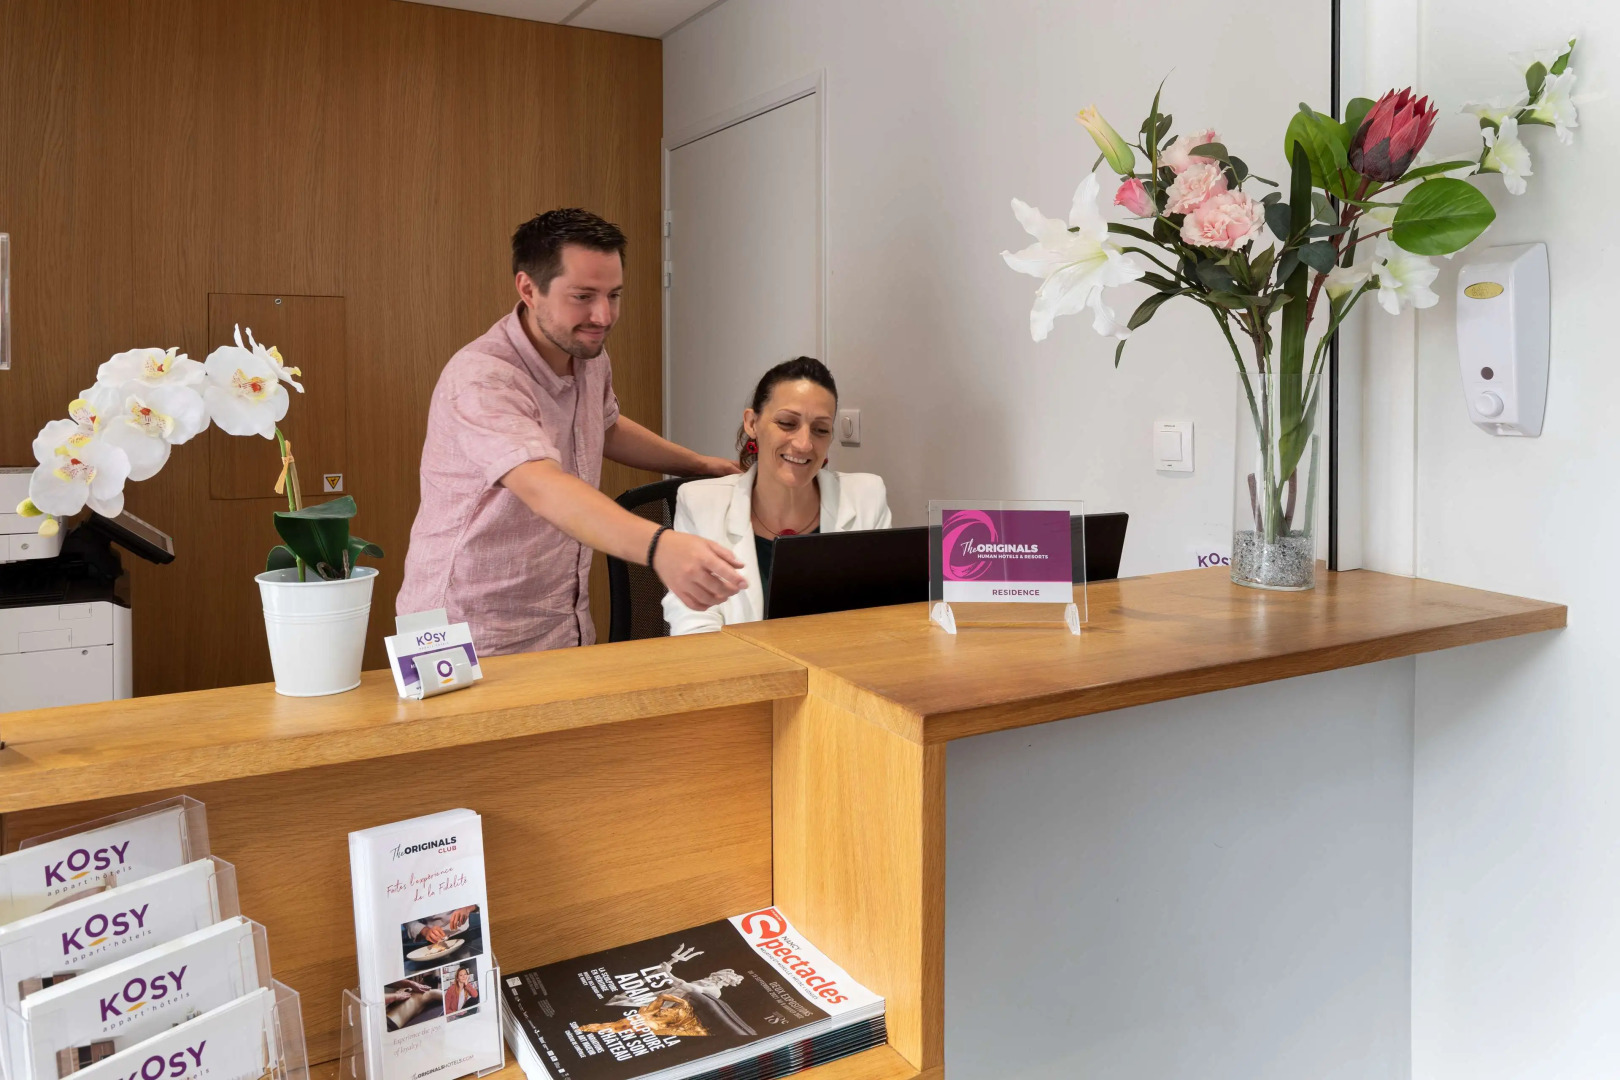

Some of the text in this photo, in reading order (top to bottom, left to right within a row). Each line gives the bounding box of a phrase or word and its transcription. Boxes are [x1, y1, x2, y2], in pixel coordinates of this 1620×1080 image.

[976, 543, 1039, 553] ORIGINALS
[1197, 552, 1232, 568] KOS
[416, 631, 447, 647] KOSY
[404, 836, 457, 855] ORIGINALS
[437, 845, 457, 854] CLUB
[44, 840, 130, 888] KOSY
[61, 903, 149, 956] KOSY
[614, 972, 658, 1006] ADAM
[640, 964, 674, 989] LES
[100, 965, 188, 1023] KOSY
[618, 1029, 649, 1057] EN SON
[623, 1009, 666, 1052] SCULPTURE
[663, 1035, 681, 1047] LA
[597, 1027, 633, 1062] CHÂTEAU
